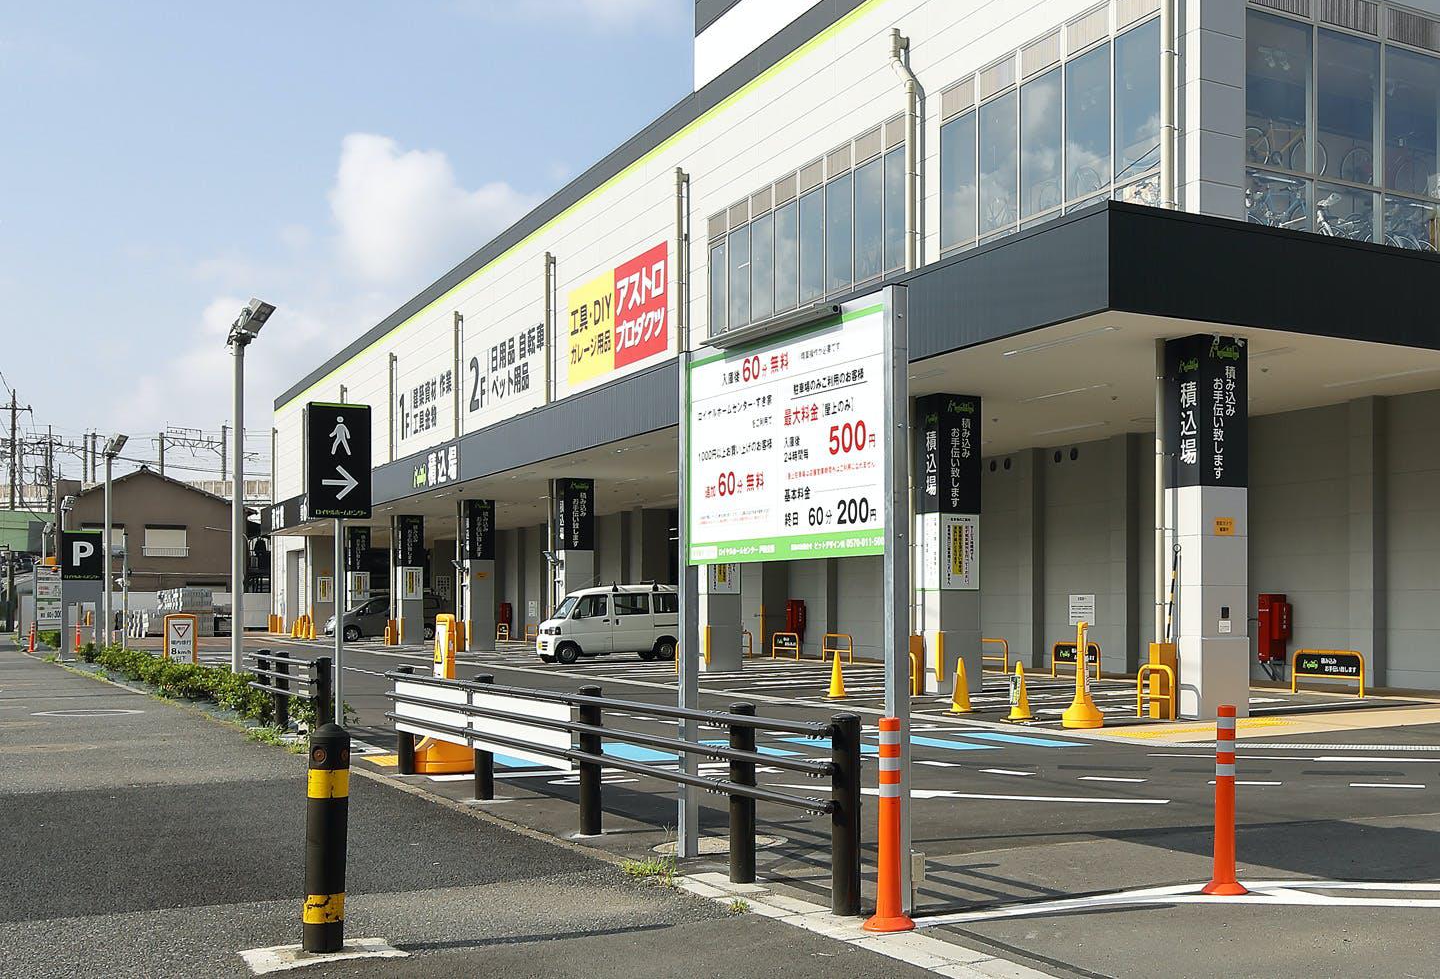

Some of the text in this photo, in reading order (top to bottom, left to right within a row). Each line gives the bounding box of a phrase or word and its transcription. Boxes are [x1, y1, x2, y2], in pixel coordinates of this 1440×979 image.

[616, 259, 665, 316] アストロ
[570, 330, 611, 365] ガレージ用品
[616, 307, 665, 353] プロダクツ
[491, 336, 515, 374] 日用品
[491, 361, 529, 399] ペット用品
[1225, 365, 1236, 417] 積み込み
[784, 403, 818, 426] 最大料金
[1179, 380, 1197, 465] 積込場
[1213, 377, 1224, 479] お手伝い致します
[925, 429, 938, 496] 積込場
[72, 541, 94, 566] P
